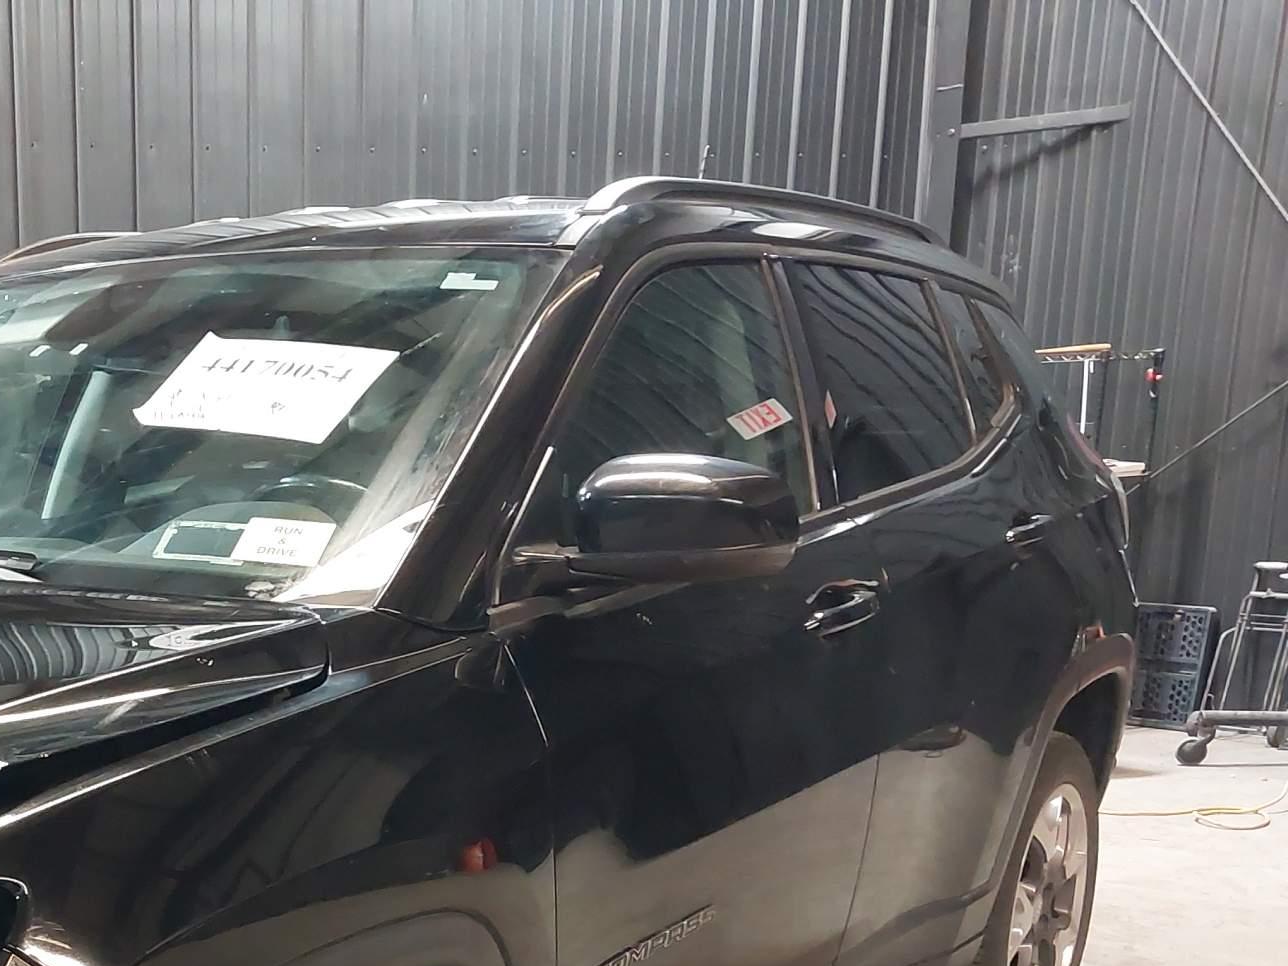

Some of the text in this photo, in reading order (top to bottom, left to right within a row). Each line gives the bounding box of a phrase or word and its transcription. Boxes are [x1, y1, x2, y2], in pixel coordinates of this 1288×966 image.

[201, 357, 354, 383] 44170054
[274, 526, 304, 535] RUN
[256, 546, 297, 557] DRIVE
